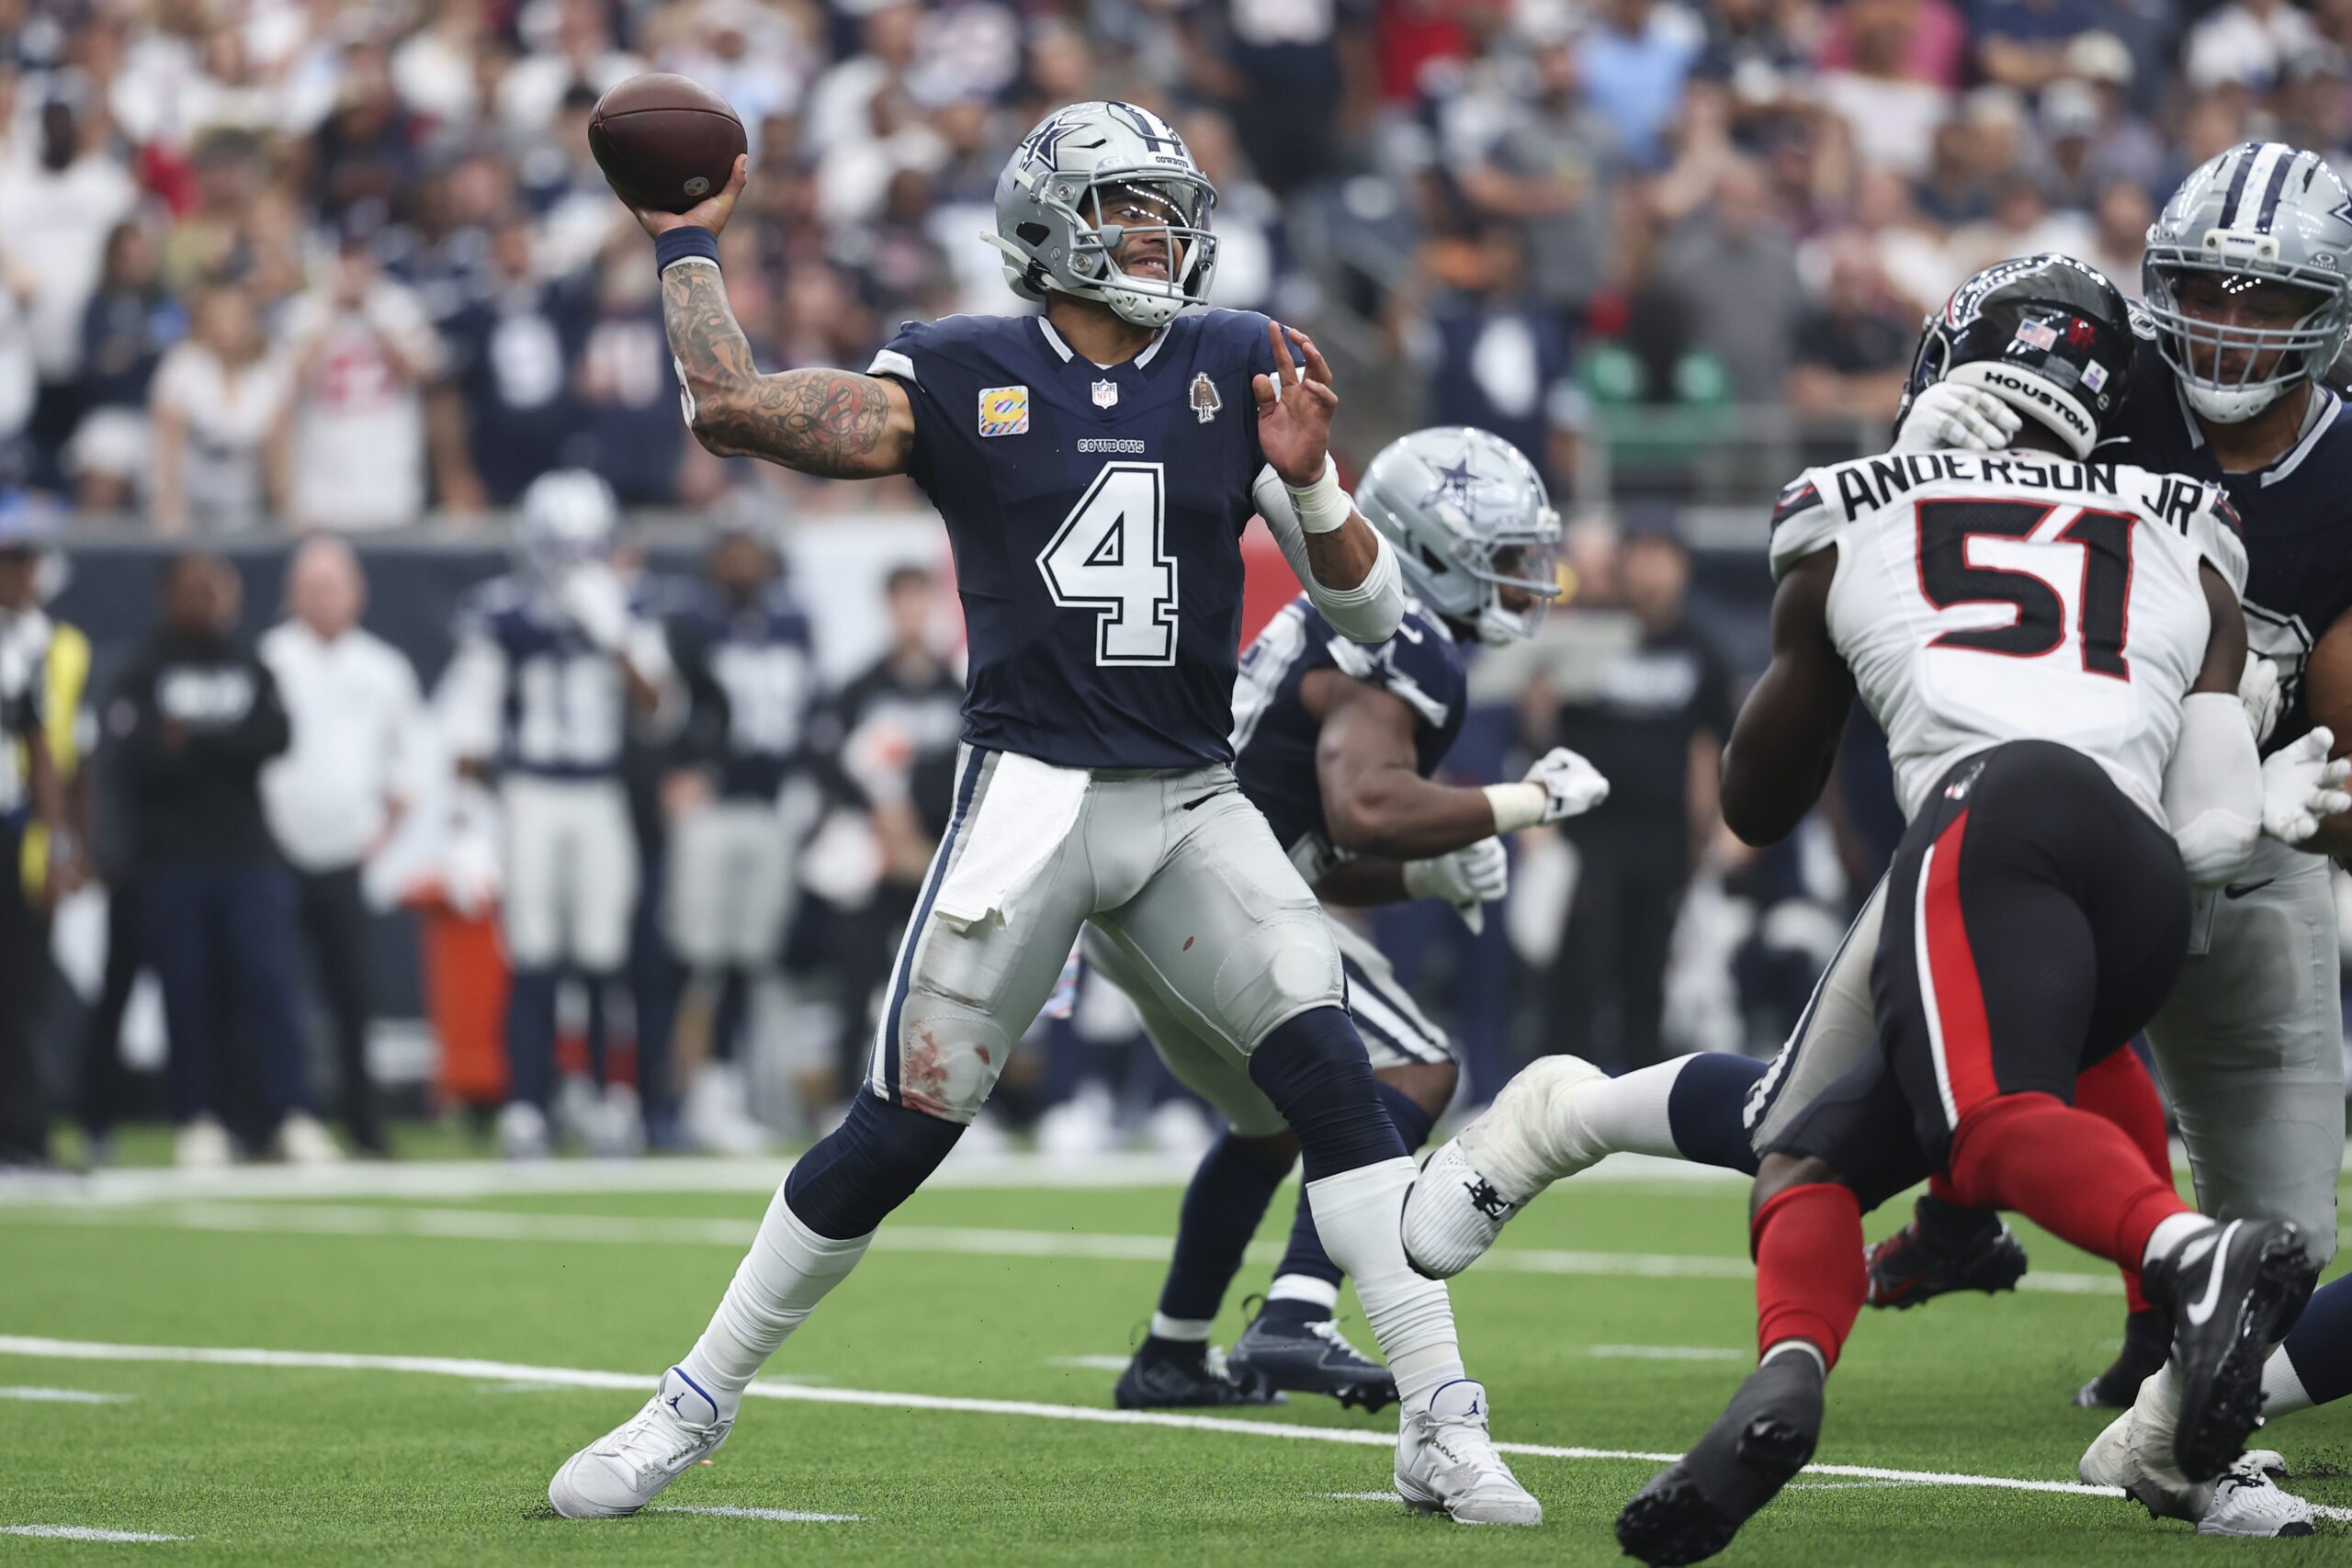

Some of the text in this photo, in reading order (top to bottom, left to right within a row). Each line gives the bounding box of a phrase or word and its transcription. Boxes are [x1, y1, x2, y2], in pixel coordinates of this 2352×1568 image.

[983, 390, 1026, 423] C
[1096, 391, 1114, 402] NFL
[1984, 372, 2088, 436] HOUSTON
[1078, 439, 1145, 454] COWBOYS
[1837, 455, 2203, 536] ANDERSON JR
[1035, 461, 1179, 667] 4
[1915, 497, 2139, 682] 51
